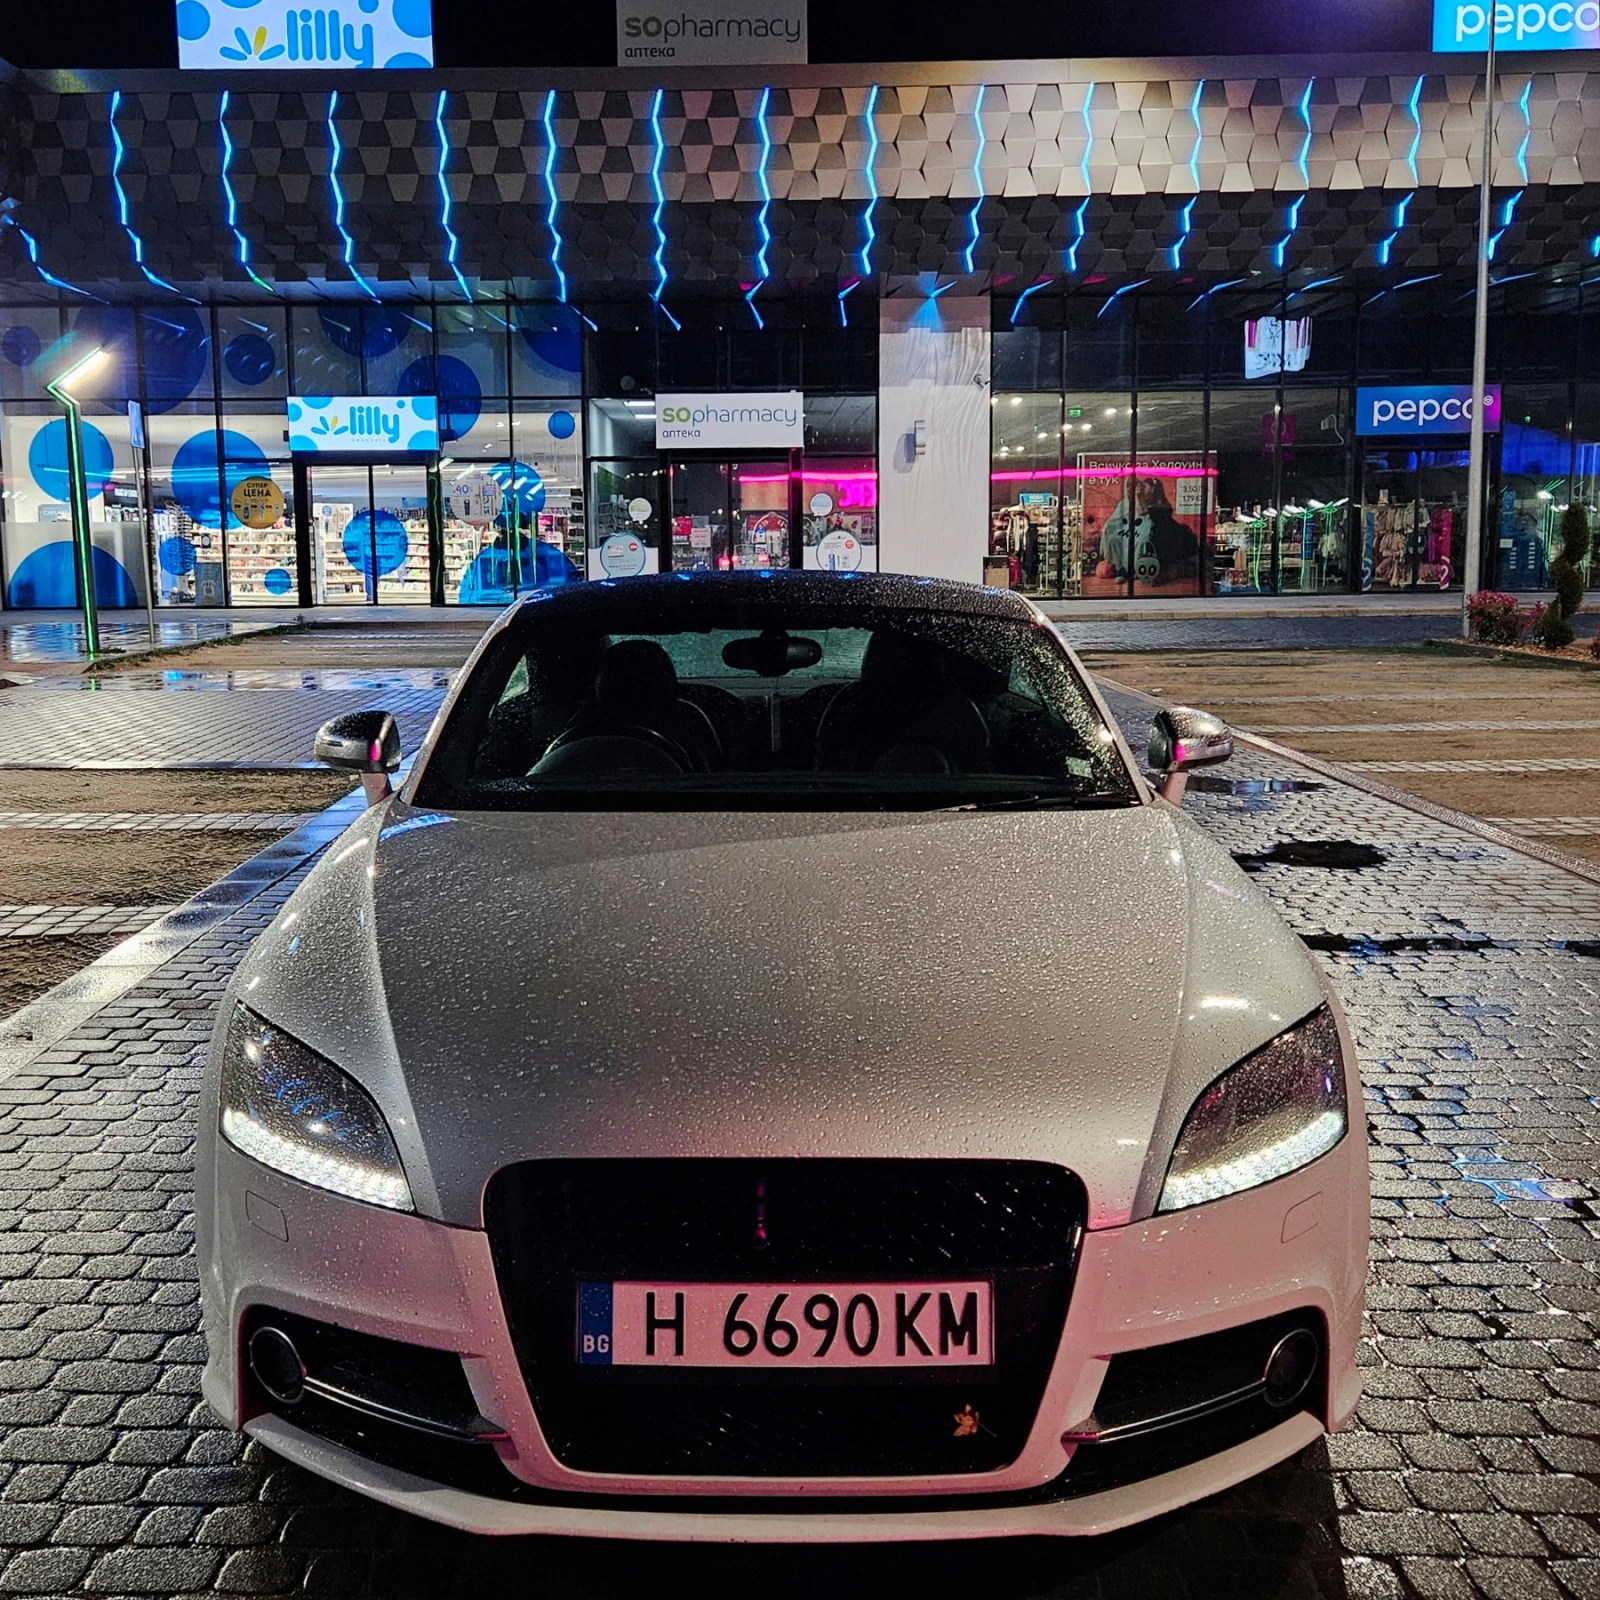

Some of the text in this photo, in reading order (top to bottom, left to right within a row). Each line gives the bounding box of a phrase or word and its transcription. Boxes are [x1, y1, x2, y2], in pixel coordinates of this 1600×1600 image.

[624, 13, 801, 43] sopharmacy
[1455, 2, 1600, 42] pepco
[286, 9, 375, 69] lilly
[624, 47, 675, 58] аптека
[349, 406, 400, 443] lilly
[662, 404, 797, 427] sopharmacy
[662, 429, 701, 438] аптека
[243, 489, 272, 498] ЦЕНА
[645, 1291, 979, 1357] H 6690 KM
[583, 1334, 609, 1354] BG
